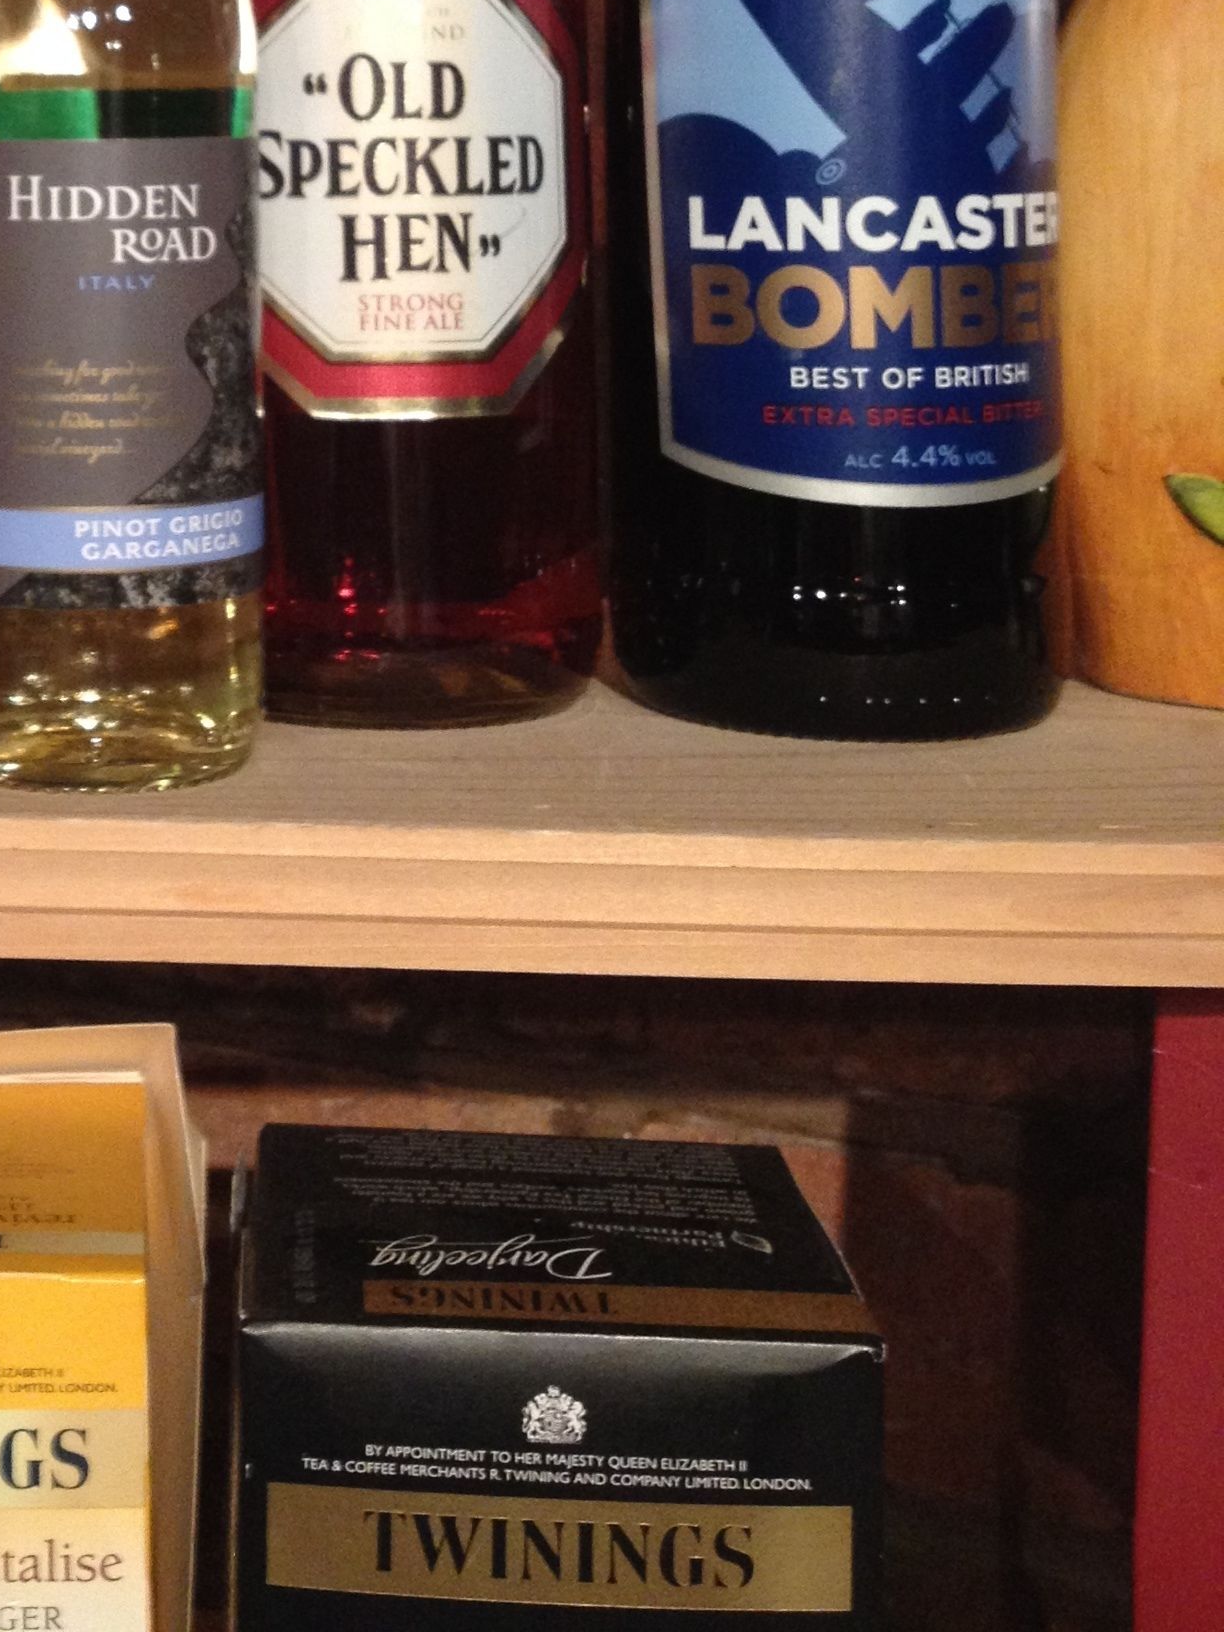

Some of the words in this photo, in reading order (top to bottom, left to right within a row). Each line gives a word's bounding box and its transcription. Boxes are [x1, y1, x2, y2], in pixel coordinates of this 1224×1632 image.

[258, 130, 545, 200] SPECKLED
[7, 174, 201, 222] HIDDEN
[112, 226, 218, 264] ROAD
[77, 274, 157, 291] ITALY
[356, 292, 465, 314] STRONG
[358, 313, 418, 333] FINE
[422, 311, 465, 331] ALE
[789, 365, 870, 391] BEST
[881, 365, 926, 390] OF
[934, 362, 1031, 389] BRITISH
[761, 404, 855, 427] EXTRA
[866, 405, 975, 428] SPECIAL
[844, 451, 883, 470] ALC
[889, 444, 960, 468] 4.4%
[963, 450, 997, 466] VOL
[73, 517, 162, 540] PINOT
[169, 509, 244, 534] GRIGIO
[81, 533, 241, 562] GARGANEGA
[368, 1233, 612, 1280] Darjeeling
[388, 1282, 619, 1316] TWININGS
[365, 1444, 382, 1456] BY
[385, 1446, 486, 1462] APPOINTMENT
[490, 1450, 511, 1463] TO
[514, 1451, 542, 1465] HER
[545, 1453, 604, 1469] MAJESTY
[608, 1456, 657, 1469] QUEEN
[661, 1458, 735, 1471] ELIZABETH
[739, 1460, 748, 1471] II
[302, 1457, 328, 1470] TEA
[331, 1460, 342, 1471] &
[344, 1460, 397, 1475] COFFEE
[400, 1464, 486, 1480] MERCHANTS
[505, 1469, 570, 1484] TWINING
[573, 1472, 607, 1485] AND
[610, 1473, 680, 1487] COMPANY
[743, 1477, 813, 1491] LONDON.
[363, 1509, 756, 1589] TWININGS
